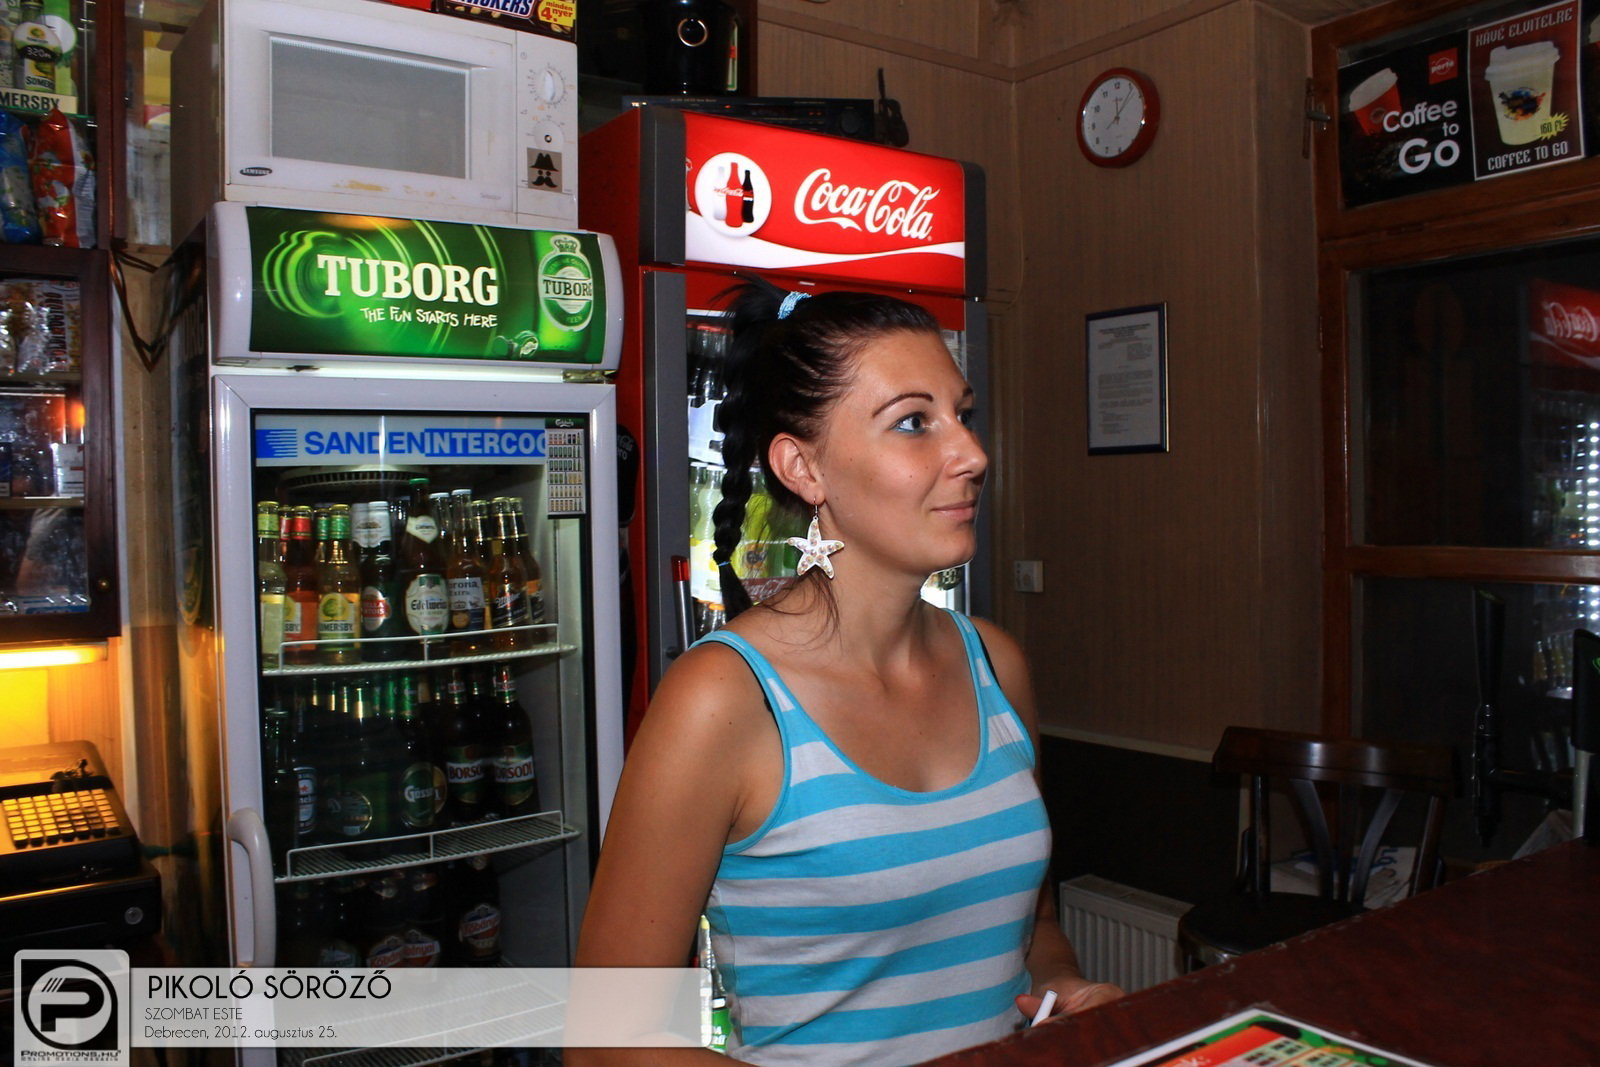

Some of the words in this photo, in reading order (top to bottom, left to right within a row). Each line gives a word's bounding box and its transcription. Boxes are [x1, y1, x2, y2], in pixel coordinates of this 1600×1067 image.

[1383, 100, 1458, 133] Coffee
[1442, 121, 1460, 137] to
[1487, 150, 1531, 171] COFFEE
[1534, 145, 1549, 159] TO
[1552, 140, 1569, 157] GO
[794, 168, 940, 240] Coca-Cola
[316, 253, 498, 306] TUBORG
[360, 307, 385, 323] THE
[415, 308, 459, 327] STARTS
[463, 313, 498, 328] HERE
[304, 431, 425, 455] SANDEN
